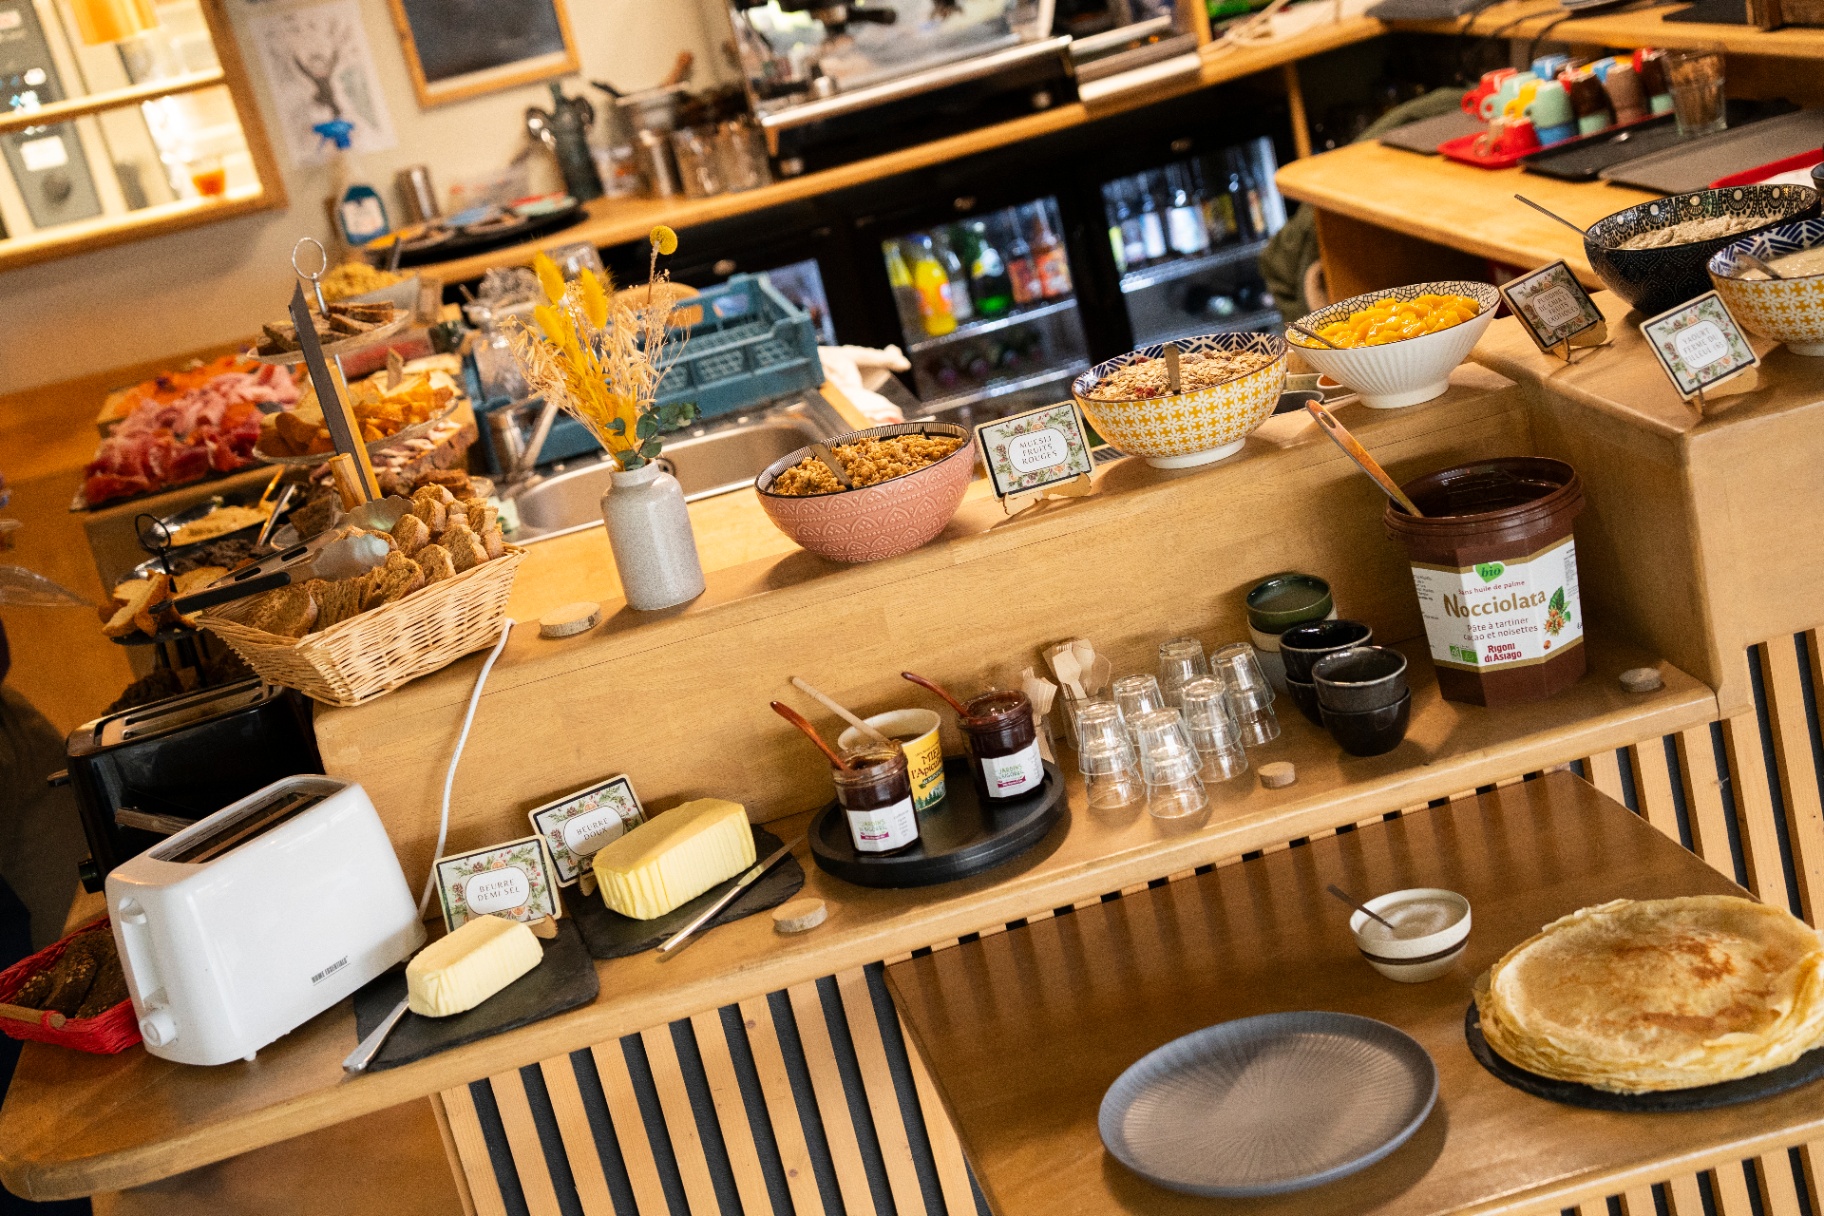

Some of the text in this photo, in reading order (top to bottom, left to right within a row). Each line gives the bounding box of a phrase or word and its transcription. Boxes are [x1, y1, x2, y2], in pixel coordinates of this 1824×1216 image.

[1020, 435, 1052, 448] MUESLI
[1022, 444, 1053, 457] FRUITS
[1022, 450, 1058, 465] ROUGES
[1481, 566, 1501, 578] bio
[1474, 585, 1492, 594] huile
[1504, 580, 1526, 590] palme
[1443, 590, 1547, 619] Nocciolata
[1467, 617, 1529, 633] Pâte à tartiner
[1463, 625, 1539, 641] cacao et noisettes
[1487, 643, 1516, 654] Rigoni
[1484, 651, 1522, 663] di Asiago
[576, 817, 608, 836] BEURRE
[583, 826, 608, 841] DOUX
[479, 879, 514, 893] BEURRE
[477, 886, 520, 902] DEMI SEL
